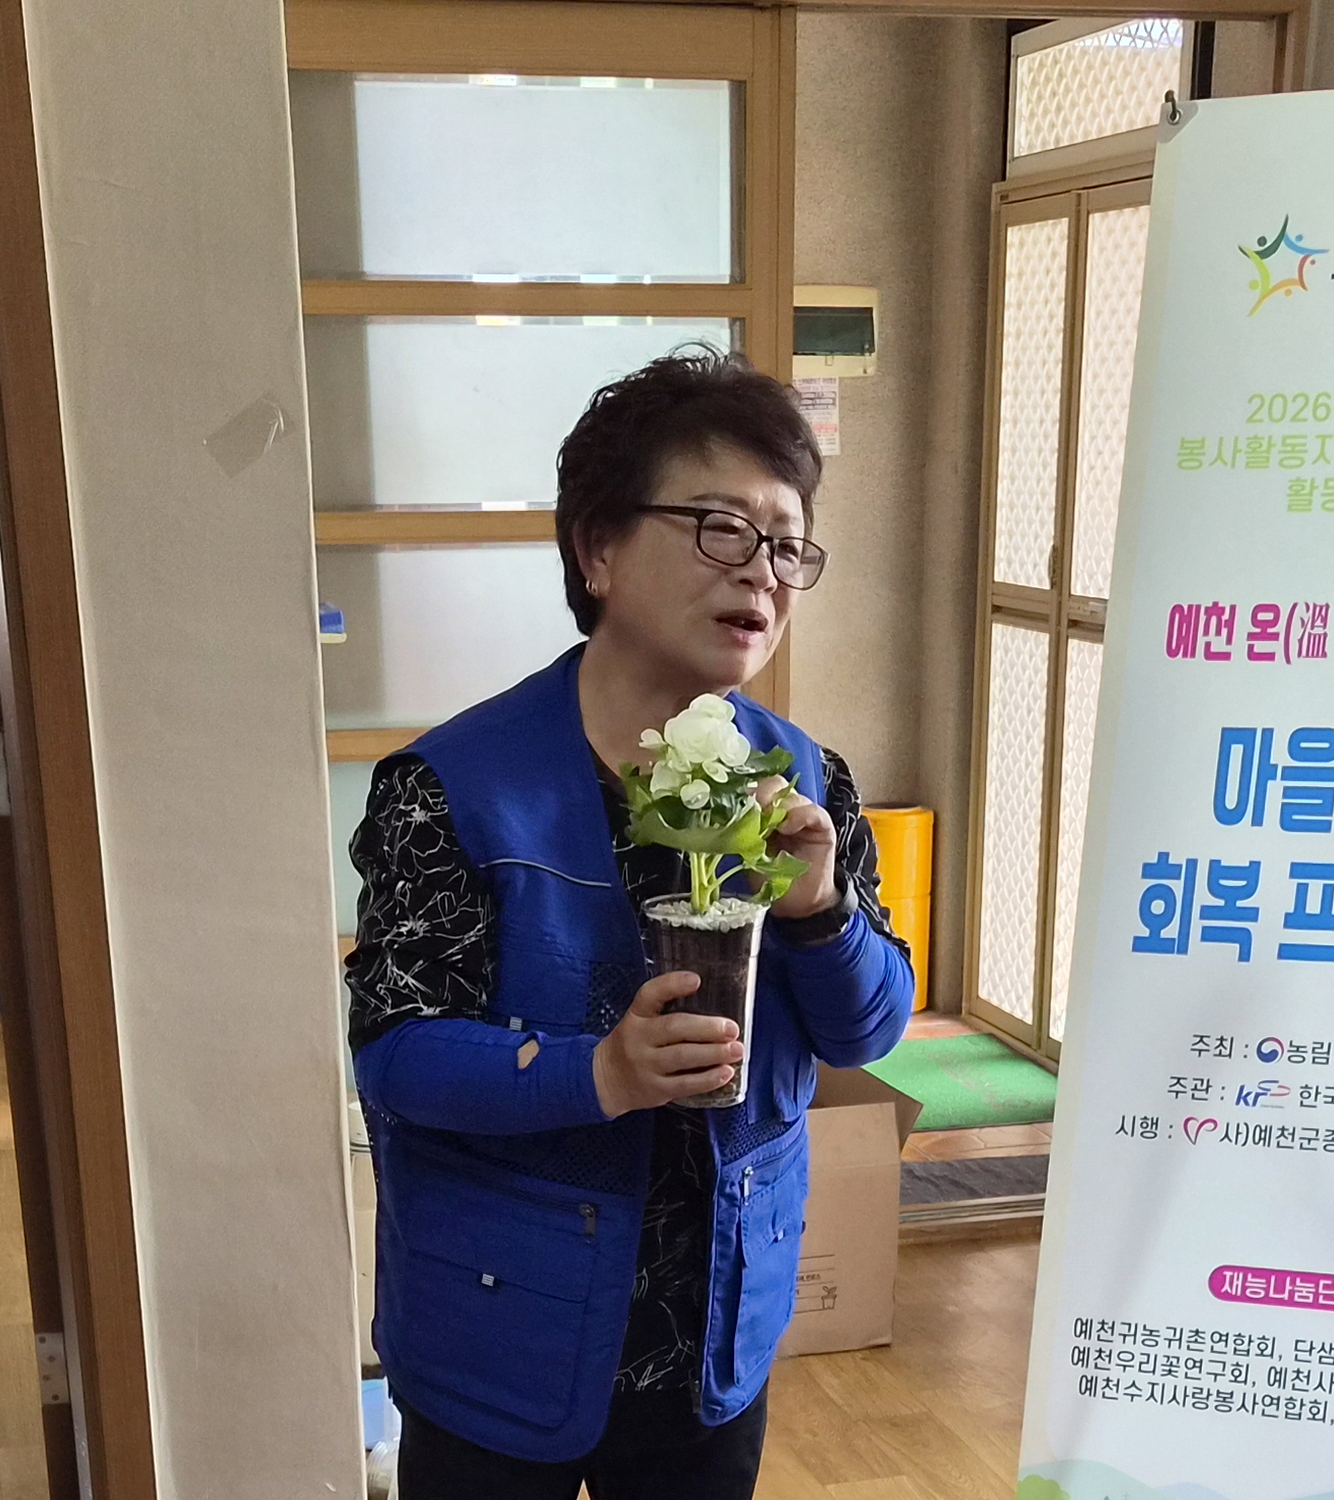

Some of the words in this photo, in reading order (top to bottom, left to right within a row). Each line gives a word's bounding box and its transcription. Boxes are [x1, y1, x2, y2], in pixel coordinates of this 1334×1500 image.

[1165, 601, 1237, 662] 예천
[1131, 851, 1262, 963] 회복
[1189, 1034, 1235, 1060] 주최
[1167, 1075, 1213, 1102] 주관
[1114, 1114, 1161, 1141] 시행
[1072, 1317, 1284, 1362] 예천귀농귀촌연합회,
[1070, 1345, 1257, 1389] 예천우리꽃연구회,
